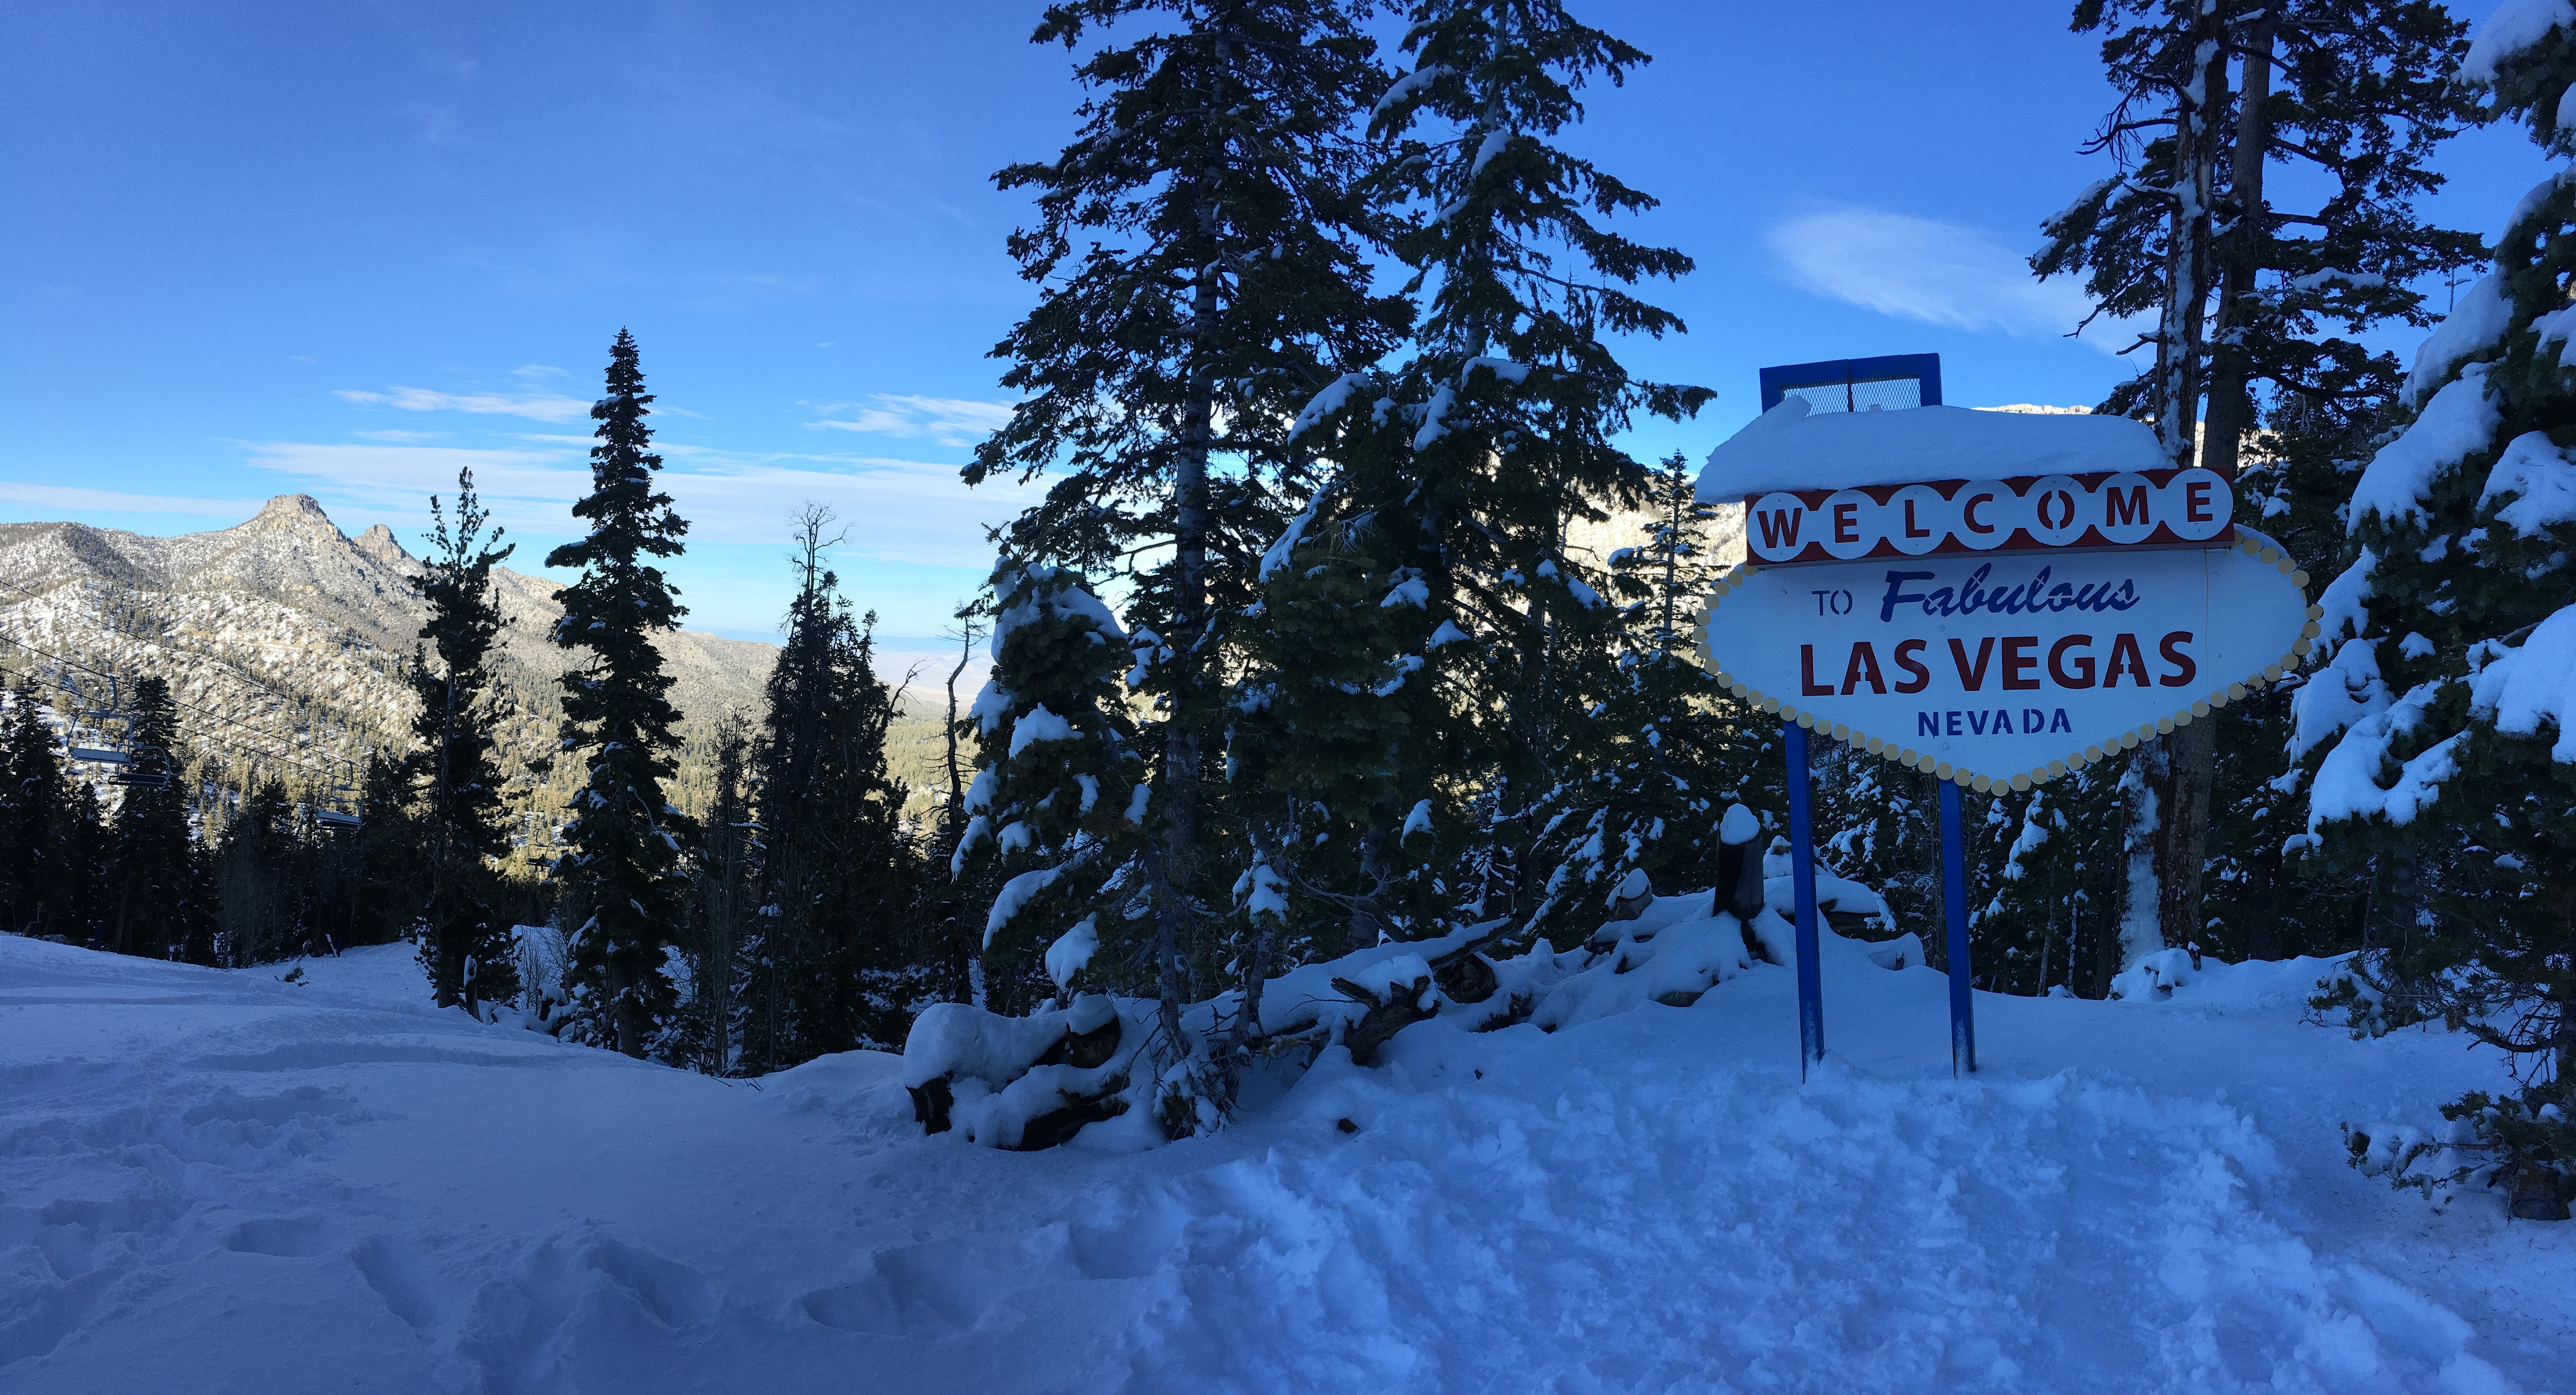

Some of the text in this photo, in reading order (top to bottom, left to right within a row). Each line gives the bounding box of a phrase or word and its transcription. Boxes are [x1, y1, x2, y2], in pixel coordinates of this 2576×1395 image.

[1757, 481, 2212, 548] WELCOME
[1812, 562, 2140, 622] TO Fabulous
[1801, 631, 2196, 696] LAS VEGAS
[1918, 709, 2072, 738] NEVADA
